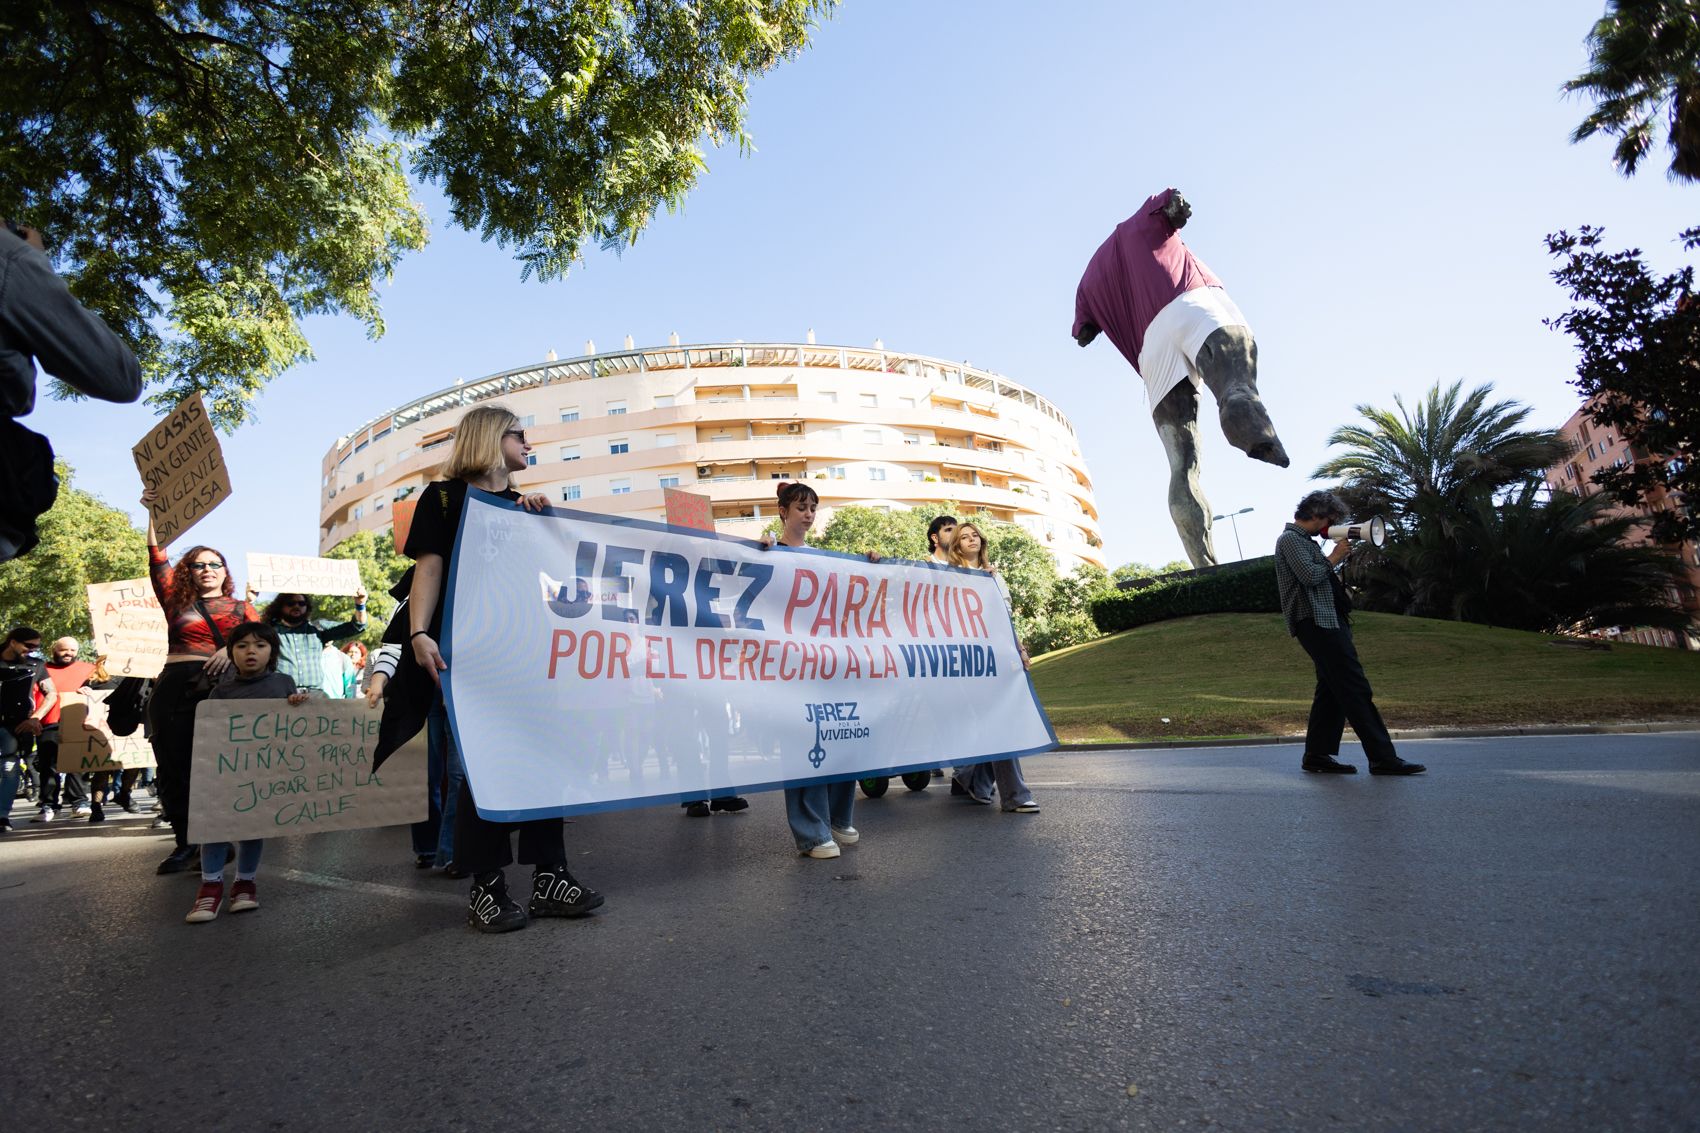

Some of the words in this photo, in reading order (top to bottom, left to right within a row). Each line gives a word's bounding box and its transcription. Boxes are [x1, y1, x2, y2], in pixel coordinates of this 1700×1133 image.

[134, 441, 154, 470] NI
[154, 401, 201, 450] CASAS
[145, 460, 170, 491] SIN
[169, 422, 212, 469] GENTE
[152, 497, 171, 520] NI
[173, 448, 220, 501] GENTE
[155, 515, 179, 544] SIN
[183, 480, 222, 520] CASA
[112, 586, 146, 600] TU
[547, 540, 775, 632] JEREZ
[783, 568, 893, 638] PARA
[902, 580, 989, 639] VIVIR
[547, 628, 632, 680] POR
[644, 634, 688, 680] EL
[695, 637, 838, 682] DERECHO
[844, 644, 861, 679] A
[864, 643, 899, 679] LA
[898, 643, 998, 678] VIVIENDA
[228, 713, 308, 742] ECHO
[310, 716, 342, 737] DE
[804, 701, 860, 723] JEREZ
[820, 726, 870, 741] VIVIENDA
[80, 751, 153, 770] MACET
[218, 743, 306, 774] NIÑXS
[317, 743, 367, 766] PARA
[233, 775, 311, 813] JUGAR
[317, 768, 343, 792] EN
[355, 771, 383, 787] LA
[274, 793, 358, 826] CALLE
[532, 872, 582, 904] AIR
